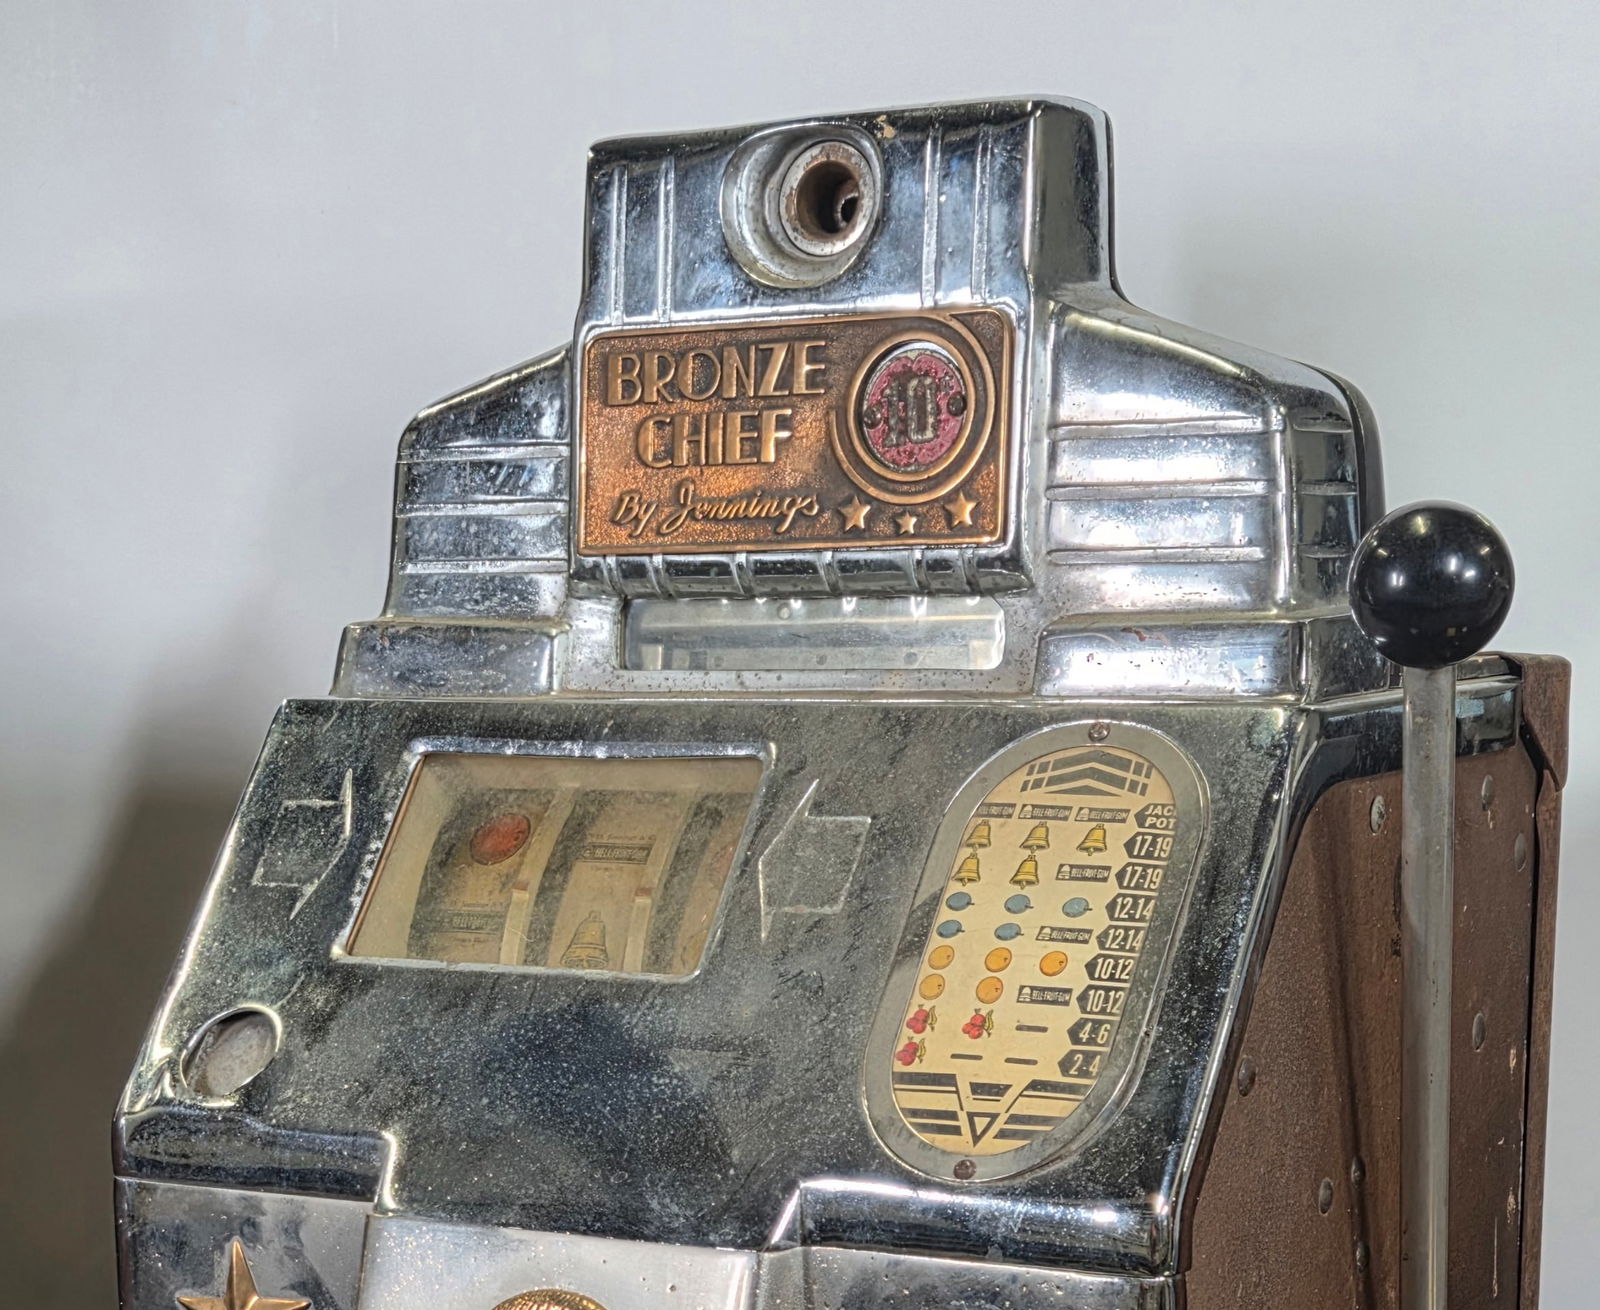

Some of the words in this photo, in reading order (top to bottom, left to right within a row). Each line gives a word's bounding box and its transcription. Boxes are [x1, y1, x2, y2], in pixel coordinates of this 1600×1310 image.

[607, 340, 826, 406] BRONZE
[637, 408, 793, 468] CHIEF
[613, 493, 657, 537] By
[659, 479, 820, 535] Jennings
[1144, 804, 1177, 817] JAC
[1144, 815, 1177, 830] POT
[1132, 834, 1174, 859] 17-19
[1122, 865, 1164, 890] 17-19
[1113, 896, 1156, 921] 12-14
[1105, 928, 1145, 950] 12-14
[1094, 957, 1135, 980] 10-12
[1086, 989, 1125, 1014] 10-12
